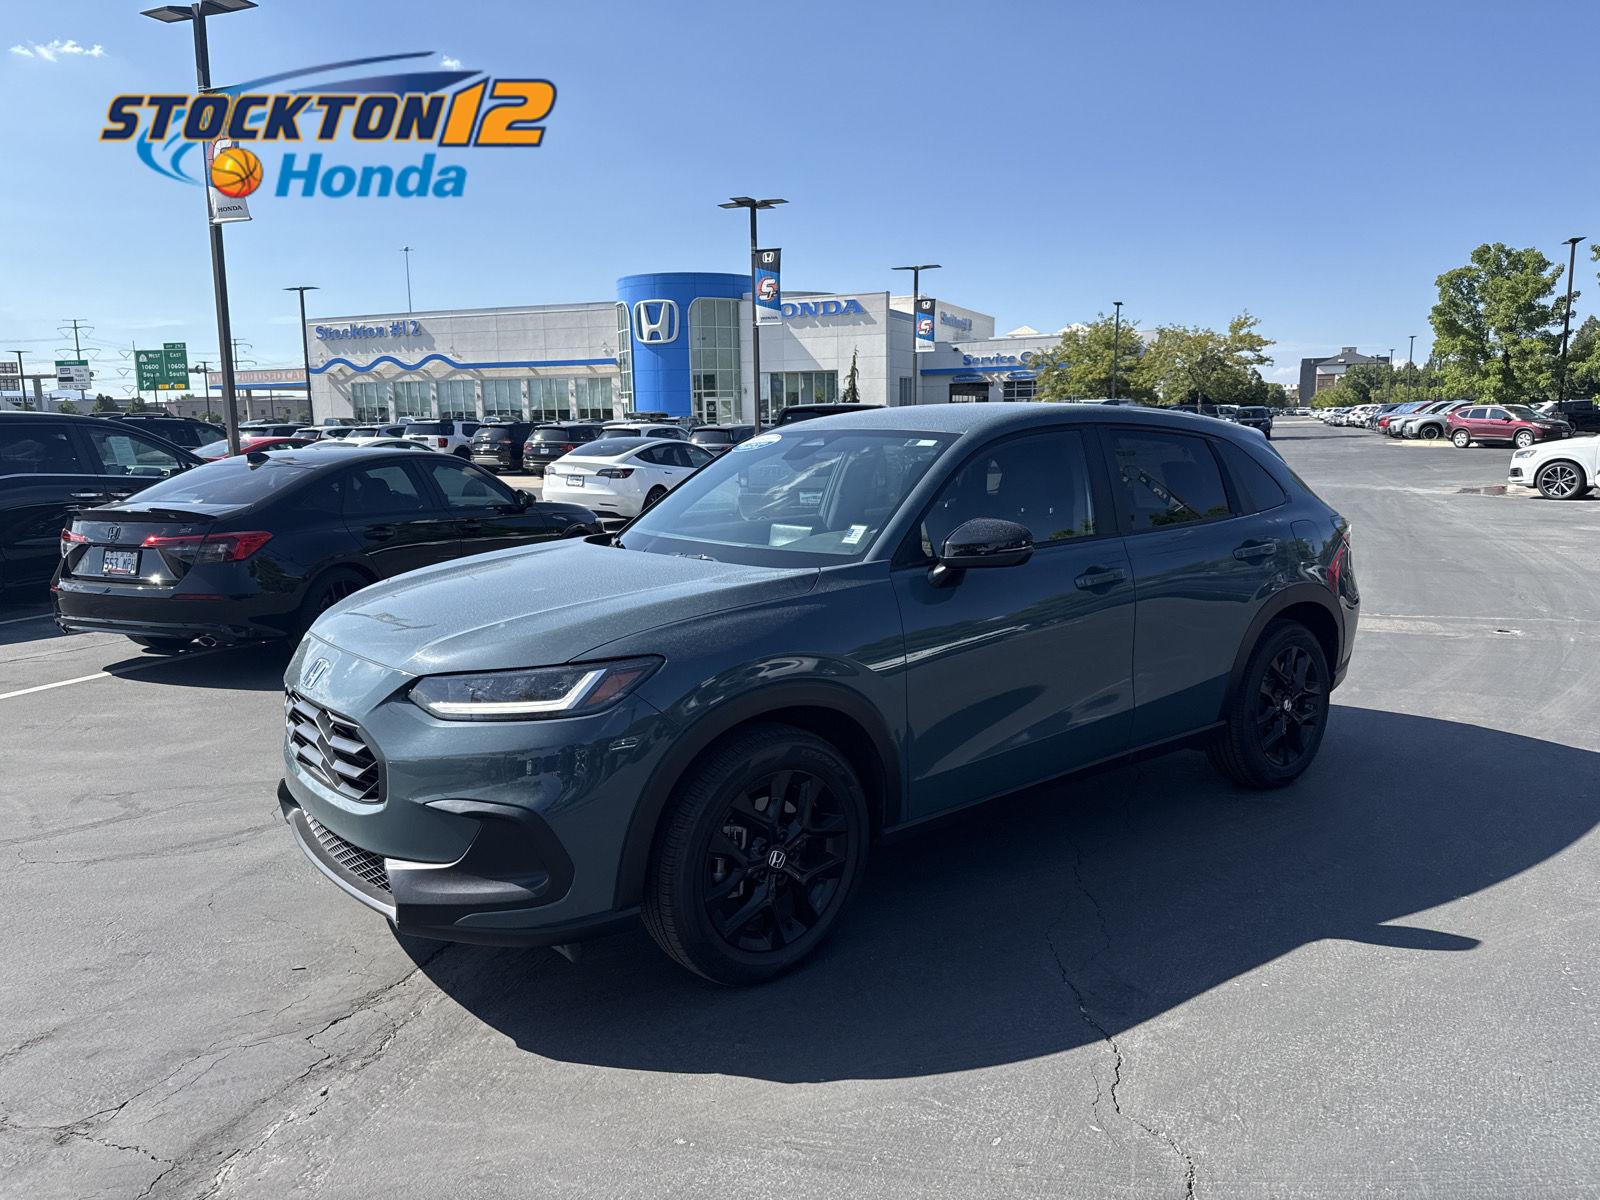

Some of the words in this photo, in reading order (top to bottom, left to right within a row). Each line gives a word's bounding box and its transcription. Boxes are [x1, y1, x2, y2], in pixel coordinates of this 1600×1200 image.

[217, 205, 243, 213] HONDA
[780, 298, 864, 318] ONDA
[315, 323, 385, 341] Stockton
[962, 352, 1016, 366] Service
[257, 372, 283, 381] USED
[285, 370, 305, 381] CAR
